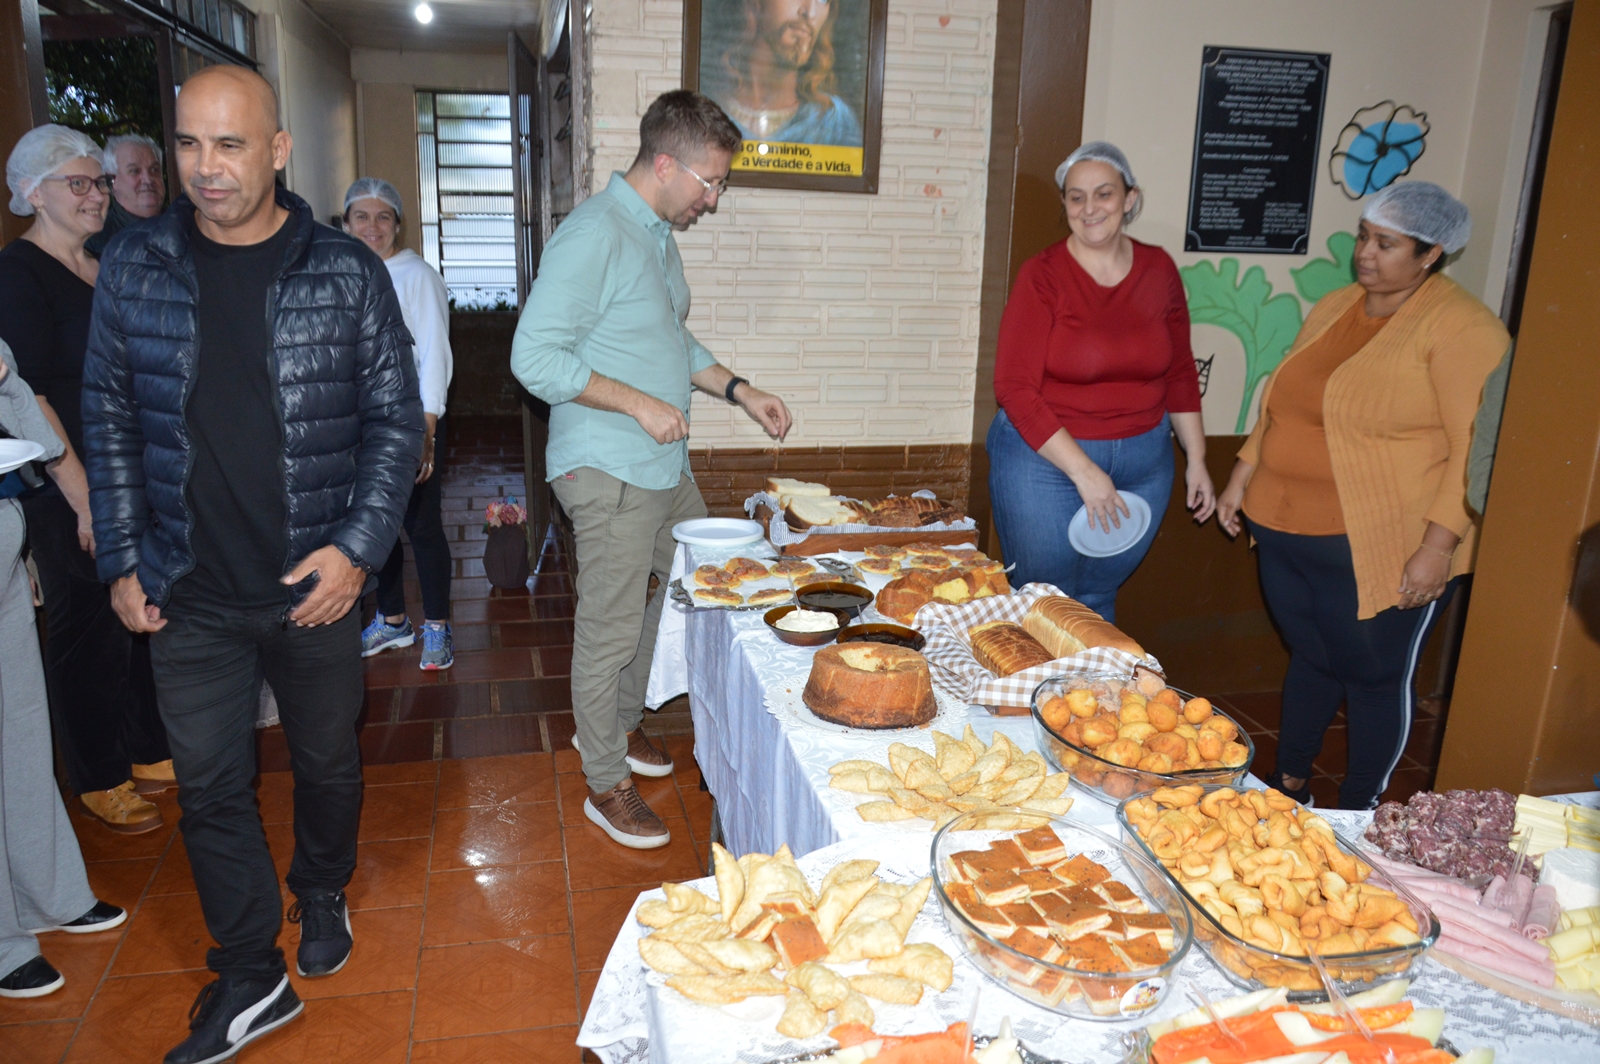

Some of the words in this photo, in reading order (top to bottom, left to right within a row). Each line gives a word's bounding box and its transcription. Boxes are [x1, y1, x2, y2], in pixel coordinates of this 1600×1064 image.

[757, 143, 812, 158] minho,
[742, 157, 750, 167] a
[752, 156, 803, 169] Verdade
[805, 161, 813, 170] e
[815, 162, 823, 171] a
